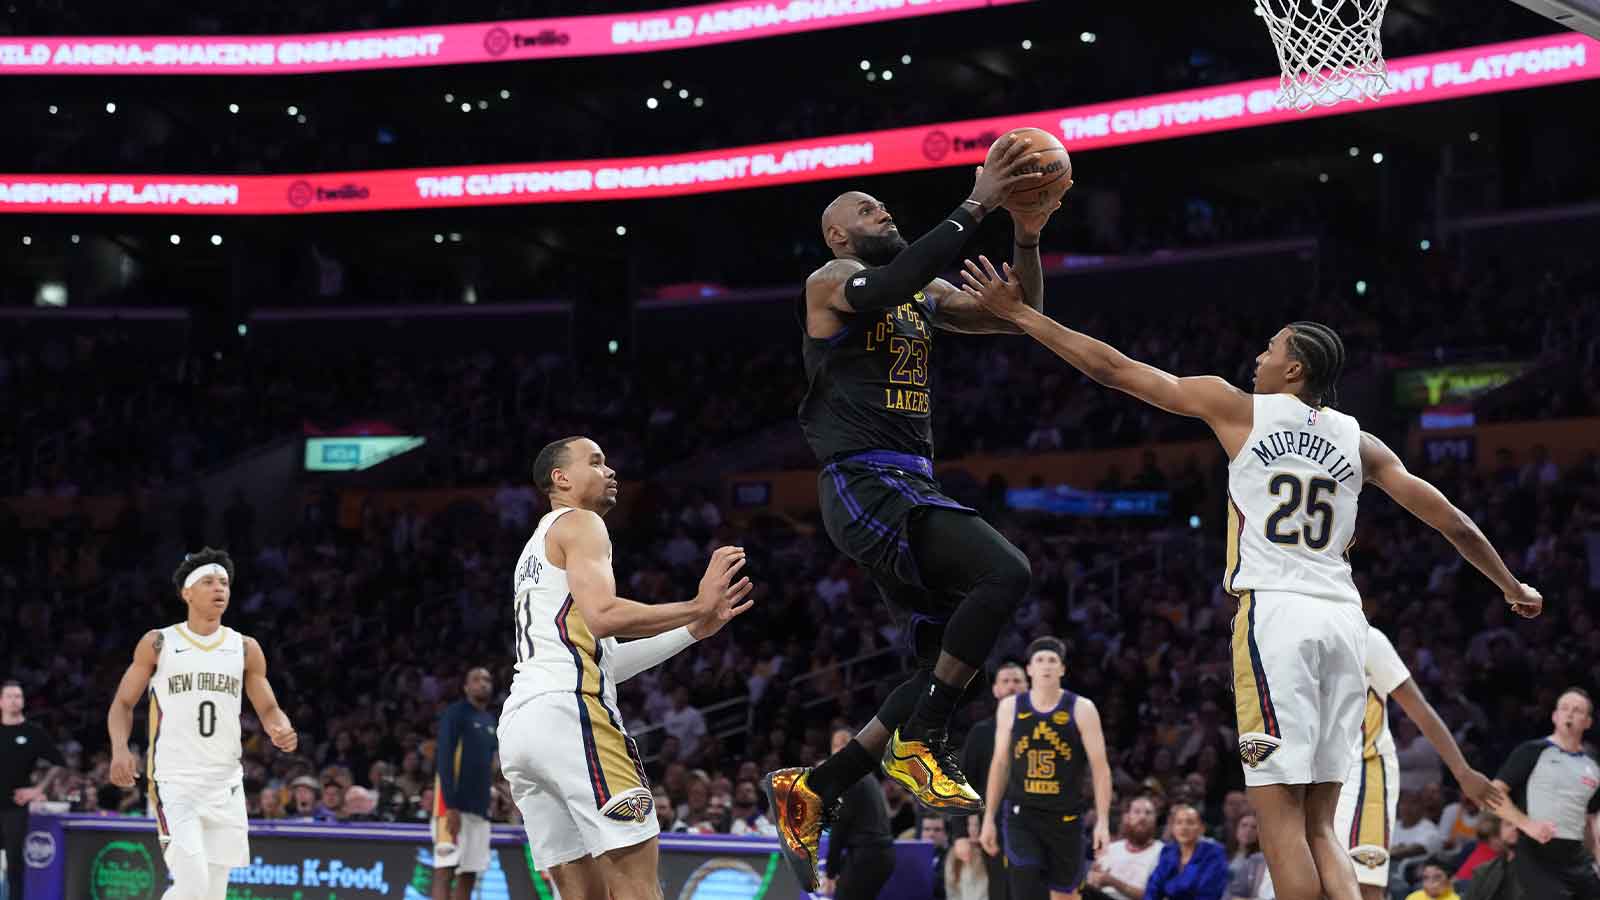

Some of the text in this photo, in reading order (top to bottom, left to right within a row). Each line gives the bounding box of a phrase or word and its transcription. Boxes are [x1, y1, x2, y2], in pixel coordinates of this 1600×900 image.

[513, 29, 570, 49] twilio
[611, 16, 694, 44] BUILD
[53, 44, 274, 65] ARENA-SHAKING
[277, 34, 444, 64] ENGAGEMENT
[1059, 114, 1109, 139] THE
[1111, 94, 1244, 132] CUSTOMER
[1432, 44, 1585, 87] PLATFORM
[416, 143, 873, 197] THE CUSTOMER ENGAGEMENT PLATFORM
[109, 183, 239, 205] PLATFORM
[866, 313, 893, 351] LOS
[889, 336, 929, 386] 23
[885, 389, 929, 413] LAKERS
[1252, 431, 1354, 482] MURPHY III
[1265, 472, 1336, 551] 25
[168, 673, 193, 696] NEW
[199, 700, 216, 738] 0
[1027, 749, 1056, 779] 15
[303, 858, 389, 895] K-Food,
